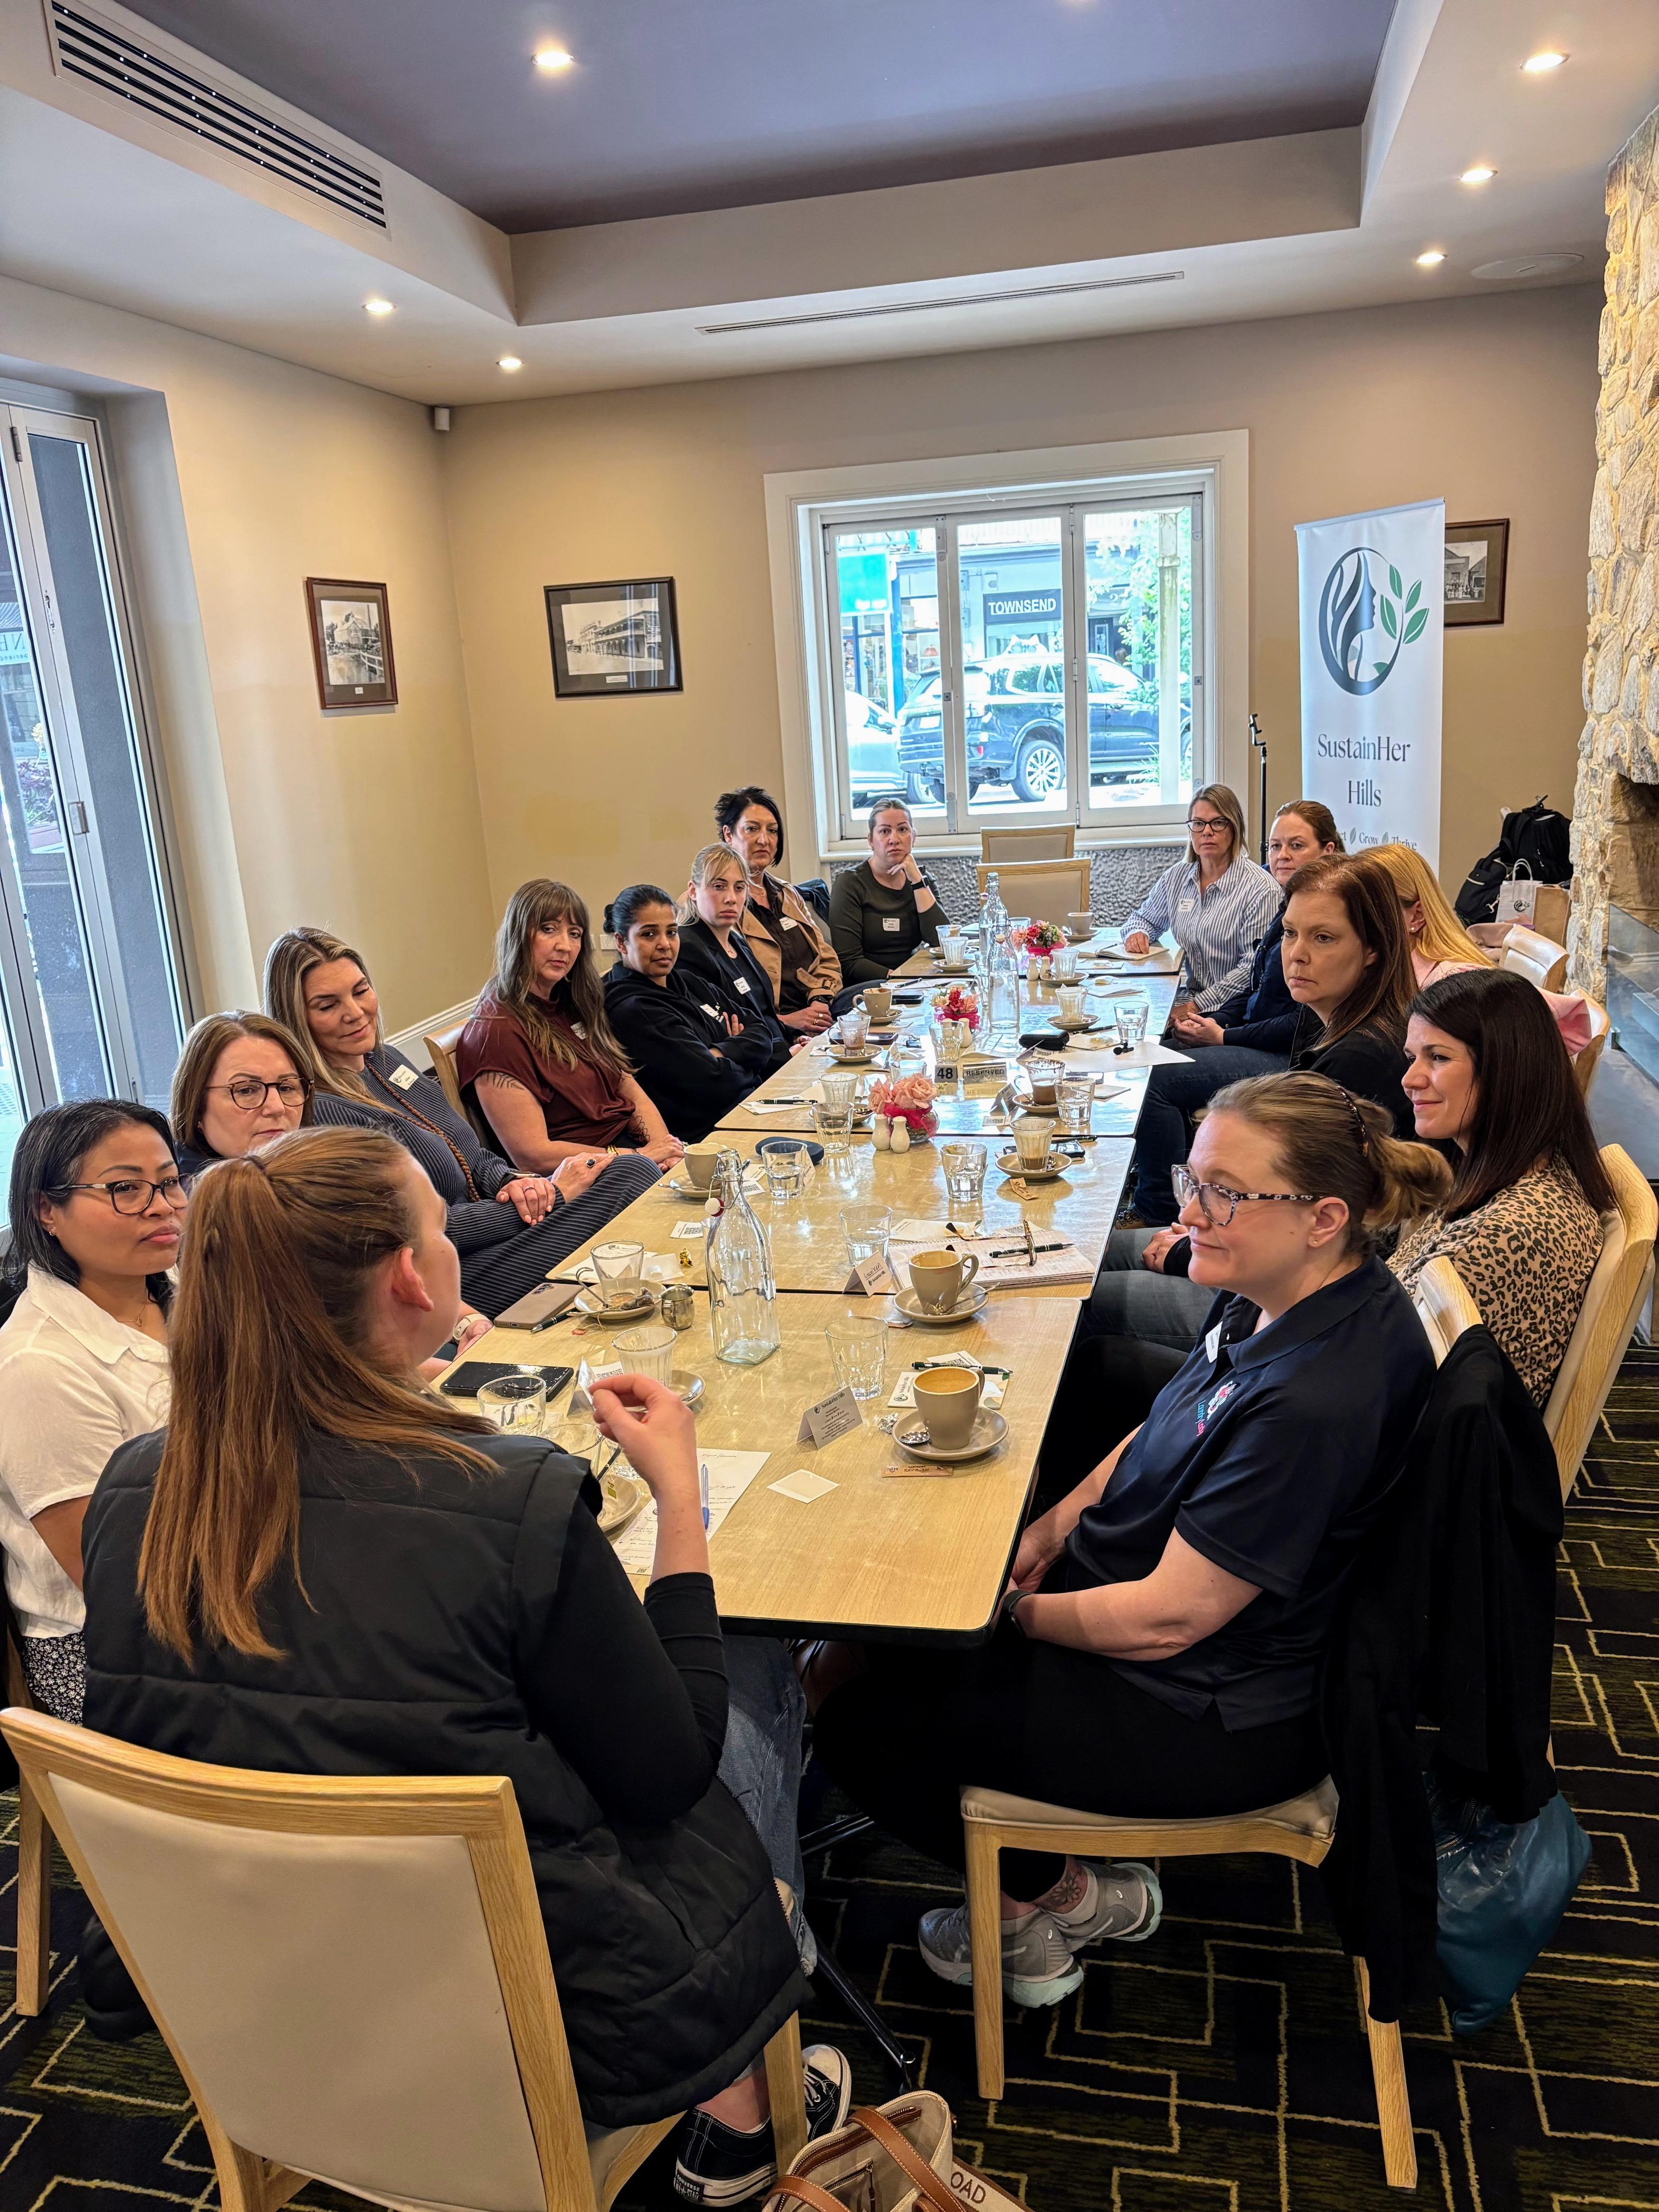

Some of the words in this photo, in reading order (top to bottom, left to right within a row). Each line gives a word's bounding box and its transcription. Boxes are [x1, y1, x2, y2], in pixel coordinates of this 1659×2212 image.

[988, 598, 1056, 615] TOWNSEND
[1318, 733, 1410, 761] SustainHer
[1348, 779, 1381, 807] Hills
[1359, 832, 1379, 845] Grow
[937, 1067, 954, 1079] 48
[950, 2171, 986, 2204] OAD
